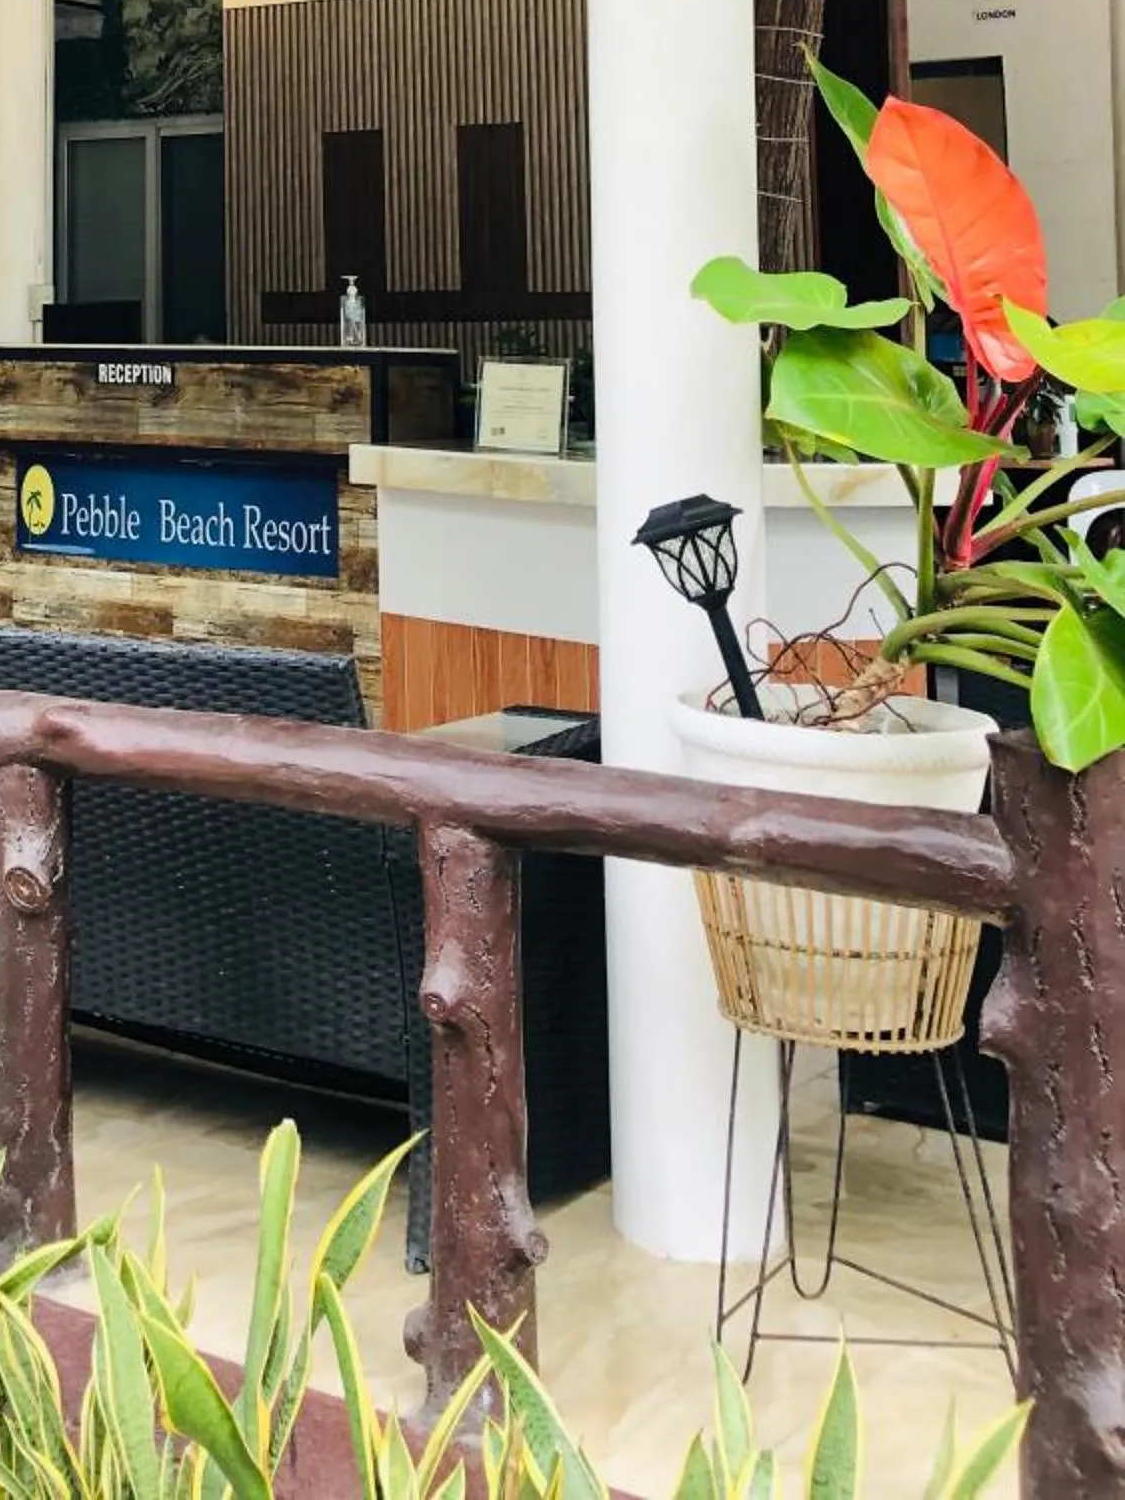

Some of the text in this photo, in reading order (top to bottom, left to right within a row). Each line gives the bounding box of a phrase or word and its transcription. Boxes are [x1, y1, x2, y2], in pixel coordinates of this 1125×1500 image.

[98, 363, 172, 384] RECEPTION
[60, 493, 332, 555] Pebble Beach Resort
